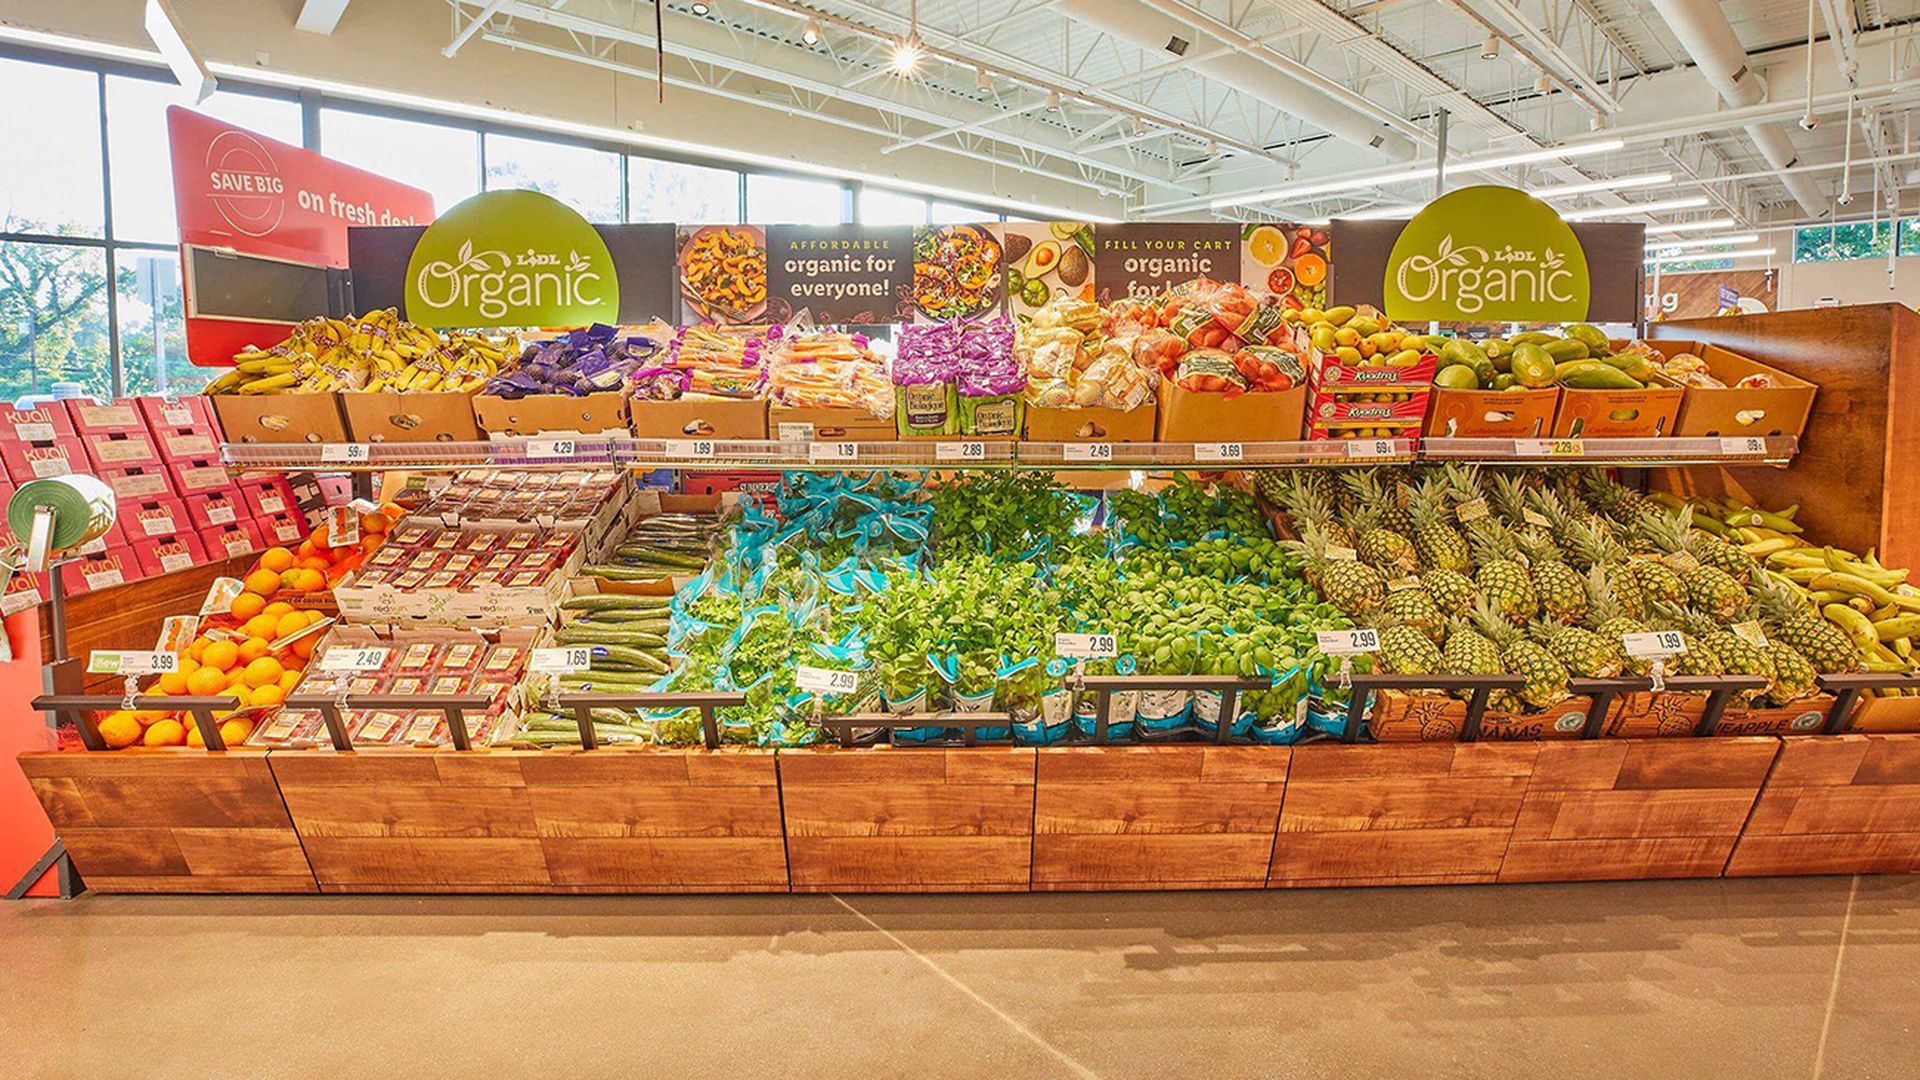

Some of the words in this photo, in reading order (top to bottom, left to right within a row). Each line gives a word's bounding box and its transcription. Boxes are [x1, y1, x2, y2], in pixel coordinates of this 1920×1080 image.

[210, 171, 253, 191] SAVE
[255, 174, 284, 194] BIG
[297, 189, 325, 213] on
[329, 192, 376, 226] fresh
[790, 240, 889, 250] AFFORDABLE
[1105, 240, 1138, 250] FILL
[1145, 240, 1186, 250] YOUR
[1193, 240, 1232, 250] CART
[784, 254, 862, 277] organic
[866, 254, 896, 272] for
[1124, 252, 1212, 278] organic
[417, 250, 602, 319] Organic
[790, 279, 890, 301] everyone!
[1127, 280, 1160, 298] for
[1396, 250, 1574, 314] Organic
[553, 441, 573, 455] 4.29
[693, 441, 711, 455] 1.99
[837, 444, 854, 456] 1.19
[962, 444, 982, 456] 2.89
[1090, 445, 1110, 457] 2.49
[1220, 445, 1240, 457] 3.69
[1555, 441, 1572, 453] 2.29
[1090, 636, 1114, 652] 2.99
[1350, 631, 1376, 648] 2.99
[1657, 633, 1681, 649] 1.99
[151, 654, 174, 669] 3.99
[355, 651, 383, 667] 2.49
[567, 650, 587, 666] 1.69
[829, 672, 855, 689] 2.99
